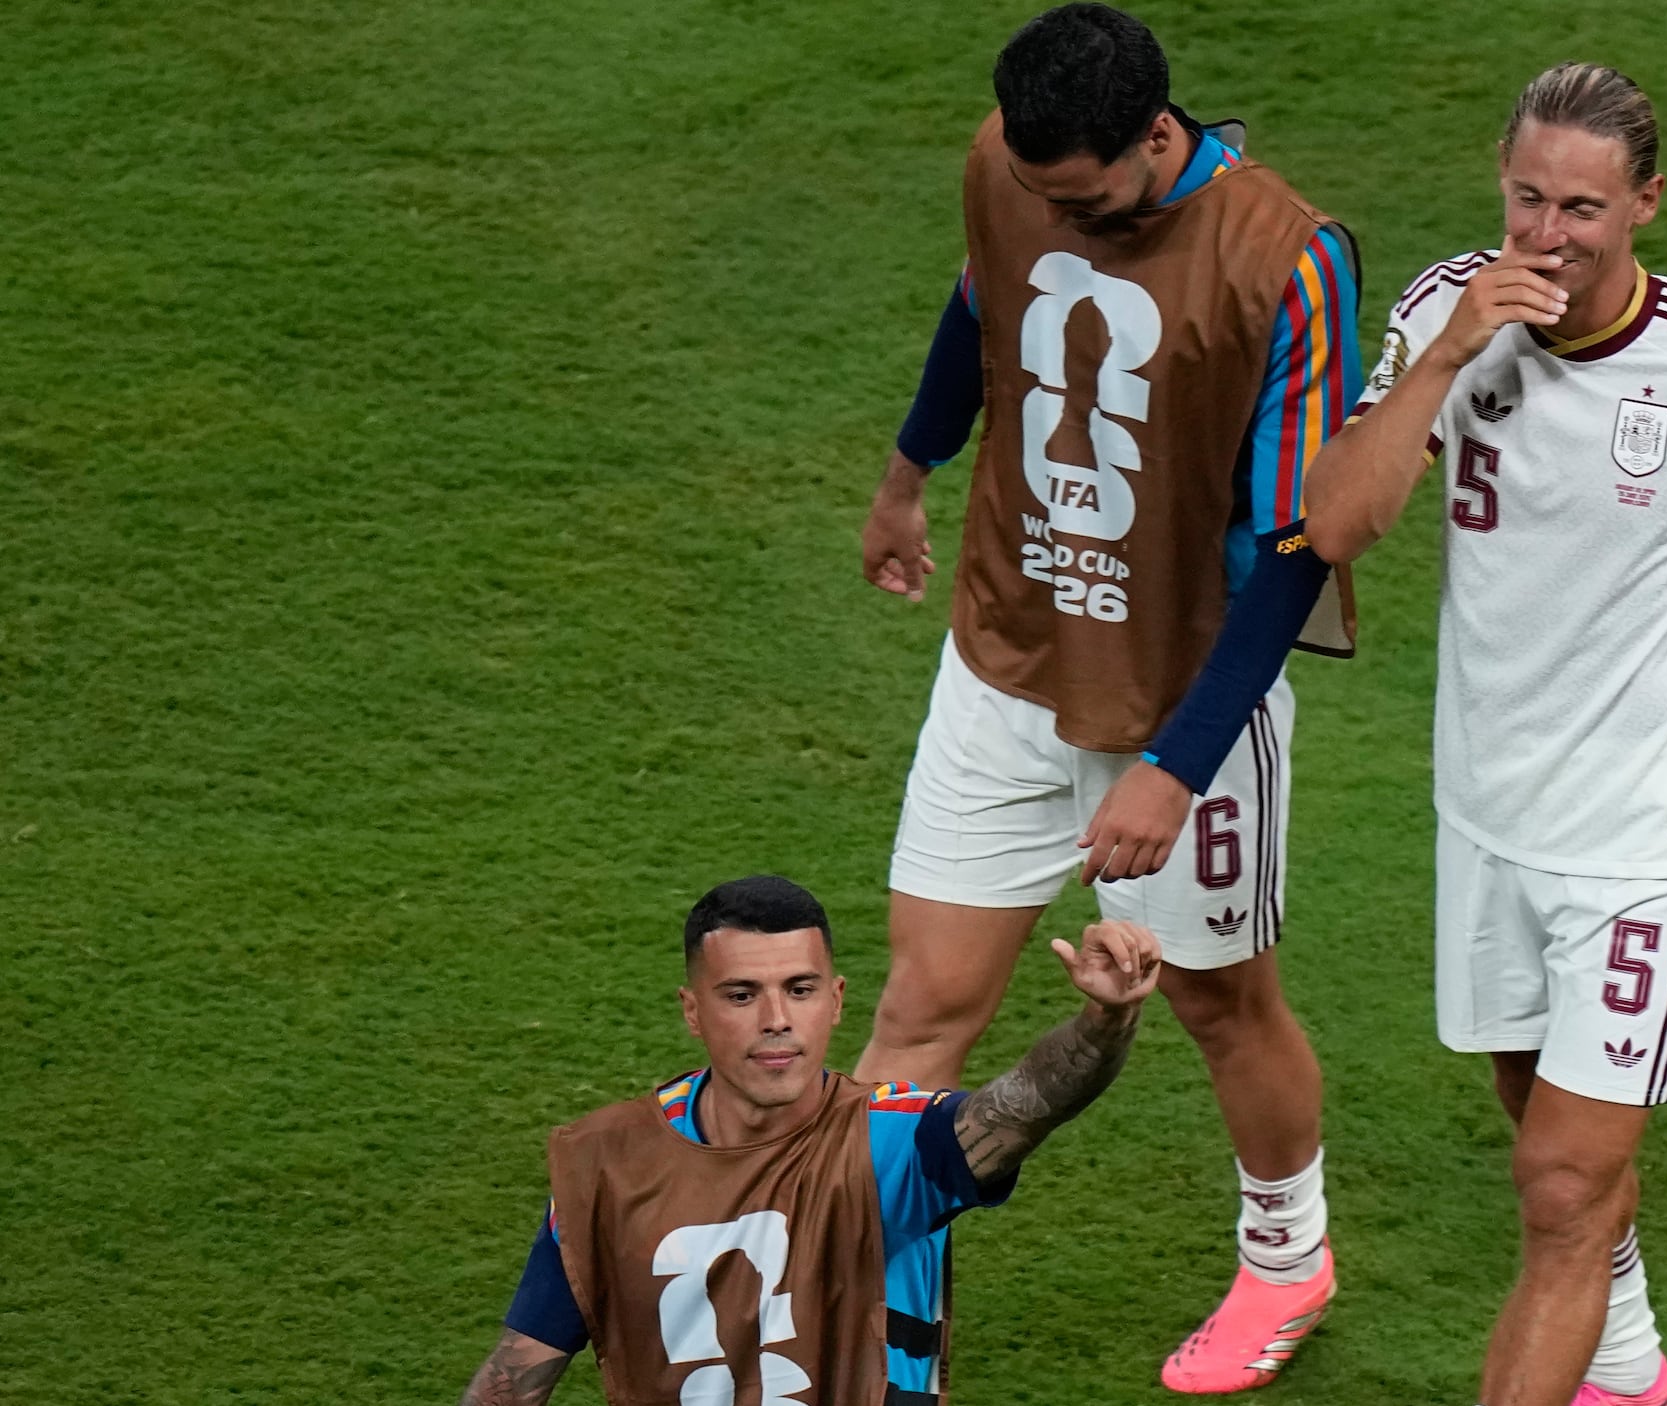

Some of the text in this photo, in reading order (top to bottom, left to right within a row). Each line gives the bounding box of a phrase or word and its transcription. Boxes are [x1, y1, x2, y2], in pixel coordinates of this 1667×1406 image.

[1046, 474, 1101, 513] IFA
[1452, 437, 1502, 533] 5
[1021, 543, 1129, 623] 226
[1078, 550, 1130, 581] CUP
[1195, 795, 1242, 889] 6
[1600, 917, 1663, 1017] 5
